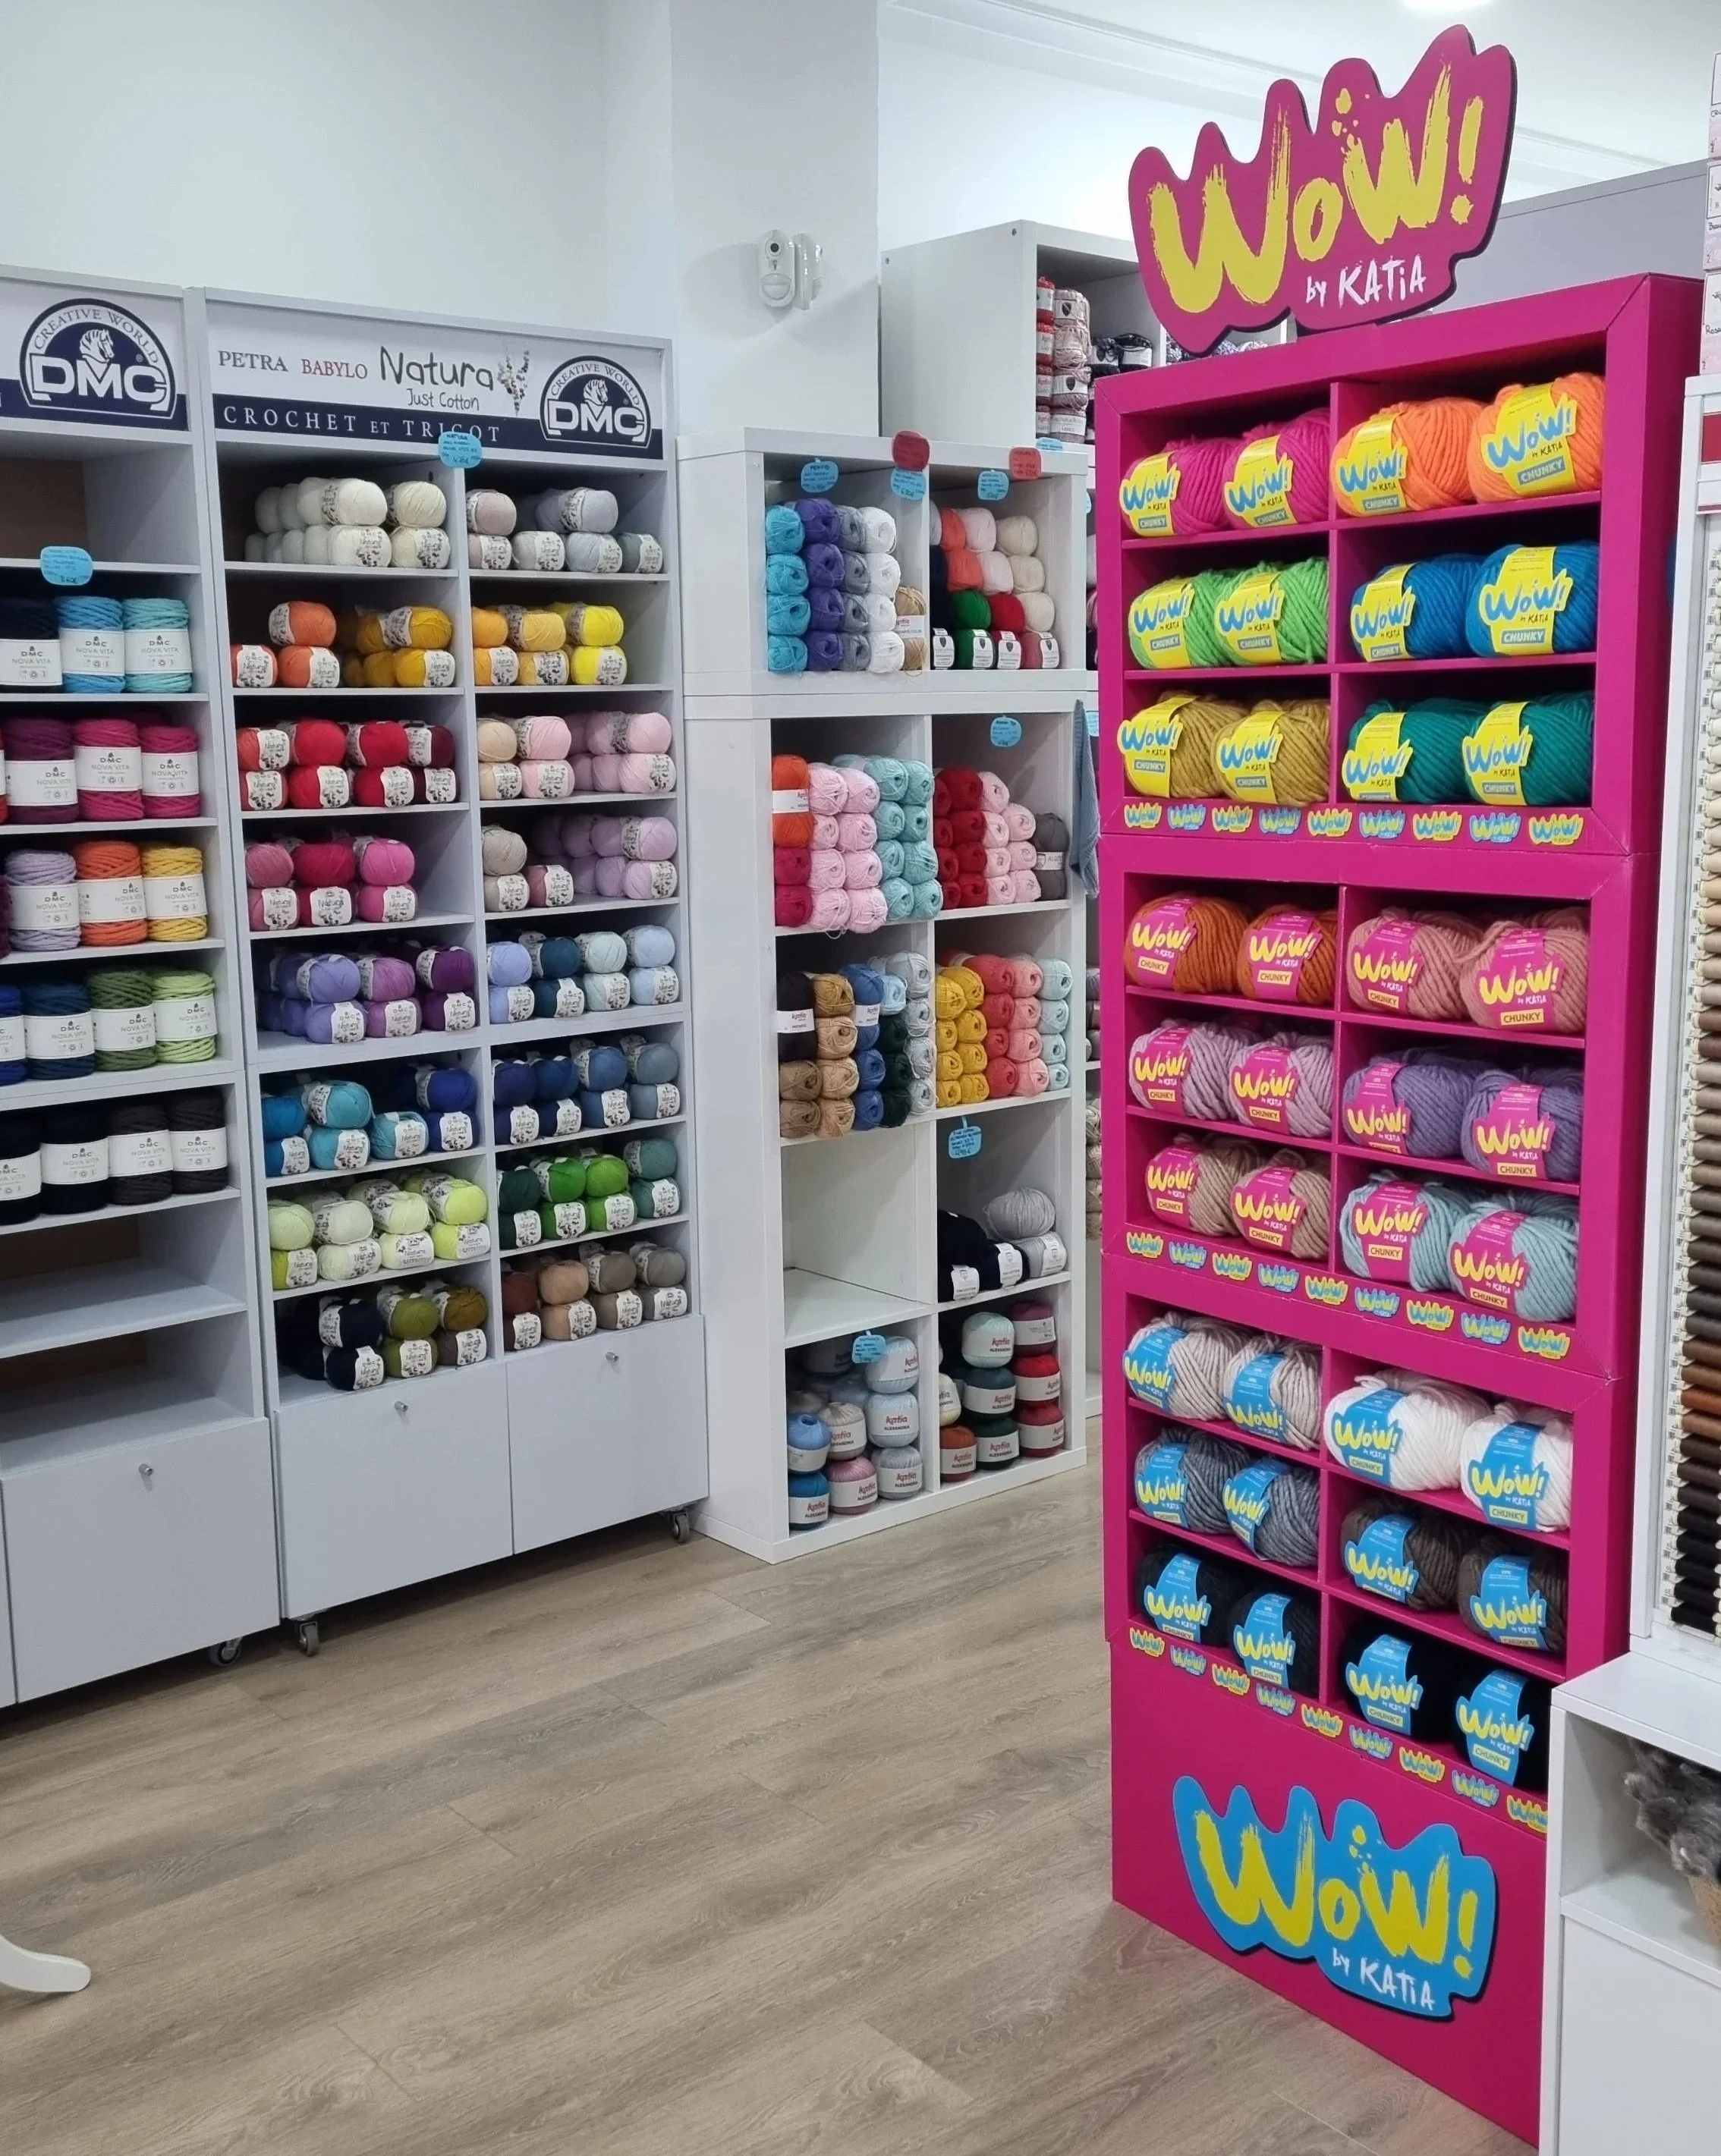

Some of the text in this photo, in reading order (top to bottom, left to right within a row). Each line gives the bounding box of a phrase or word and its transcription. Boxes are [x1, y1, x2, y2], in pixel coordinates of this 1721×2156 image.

[1147, 61, 1483, 313] WoW!
[1306, 275, 1327, 307] by
[34, 309, 159, 363] CREATIVE WORLD
[218, 350, 368, 379] PETRA BABYLO
[380, 346, 494, 391] Natura
[31, 356, 169, 411] DMC
[552, 363, 640, 406] CREATIVE WORLD
[407, 388, 480, 411] Just Cotton
[224, 406, 356, 432] CROCHET
[371, 421, 389, 433] ET
[548, 401, 647, 442] DMC
[1487, 407, 1571, 467] WoW!
[1340, 452, 1403, 492] WoW!
[1520, 458, 1565, 482] CHUNKY
[1123, 476, 1175, 511] WoW!
[1229, 468, 1288, 512] WoW!
[1364, 498, 1398, 509] CHUNKY
[1141, 517, 1166, 528] CHUNKY
[1257, 510, 1286, 524] CHUNKY
[1134, 595, 1189, 633] WoW!
[1219, 594, 1279, 632] WoW!
[1484, 580, 1565, 621] WoW!
[1355, 597, 1410, 638] WoW!
[1151, 635, 1179, 649] CHUNKY
[1239, 637, 1271, 649] CHUNKY
[1504, 630, 1543, 643] CHUNKY
[1372, 645, 1401, 658] CHUNKY
[1121, 721, 1175, 750] WoW!
[1220, 735, 1276, 768] WoW!
[1467, 736, 1527, 772] WoW!
[1136, 762, 1165, 772] CHUNKY
[1346, 749, 1404, 784] WoW!
[1237, 778, 1266, 787] CHUNKY
[1484, 784, 1515, 794] CHUNKY
[1132, 922, 1191, 951] WoW!
[1250, 932, 1315, 963] WoW!
[1141, 959, 1166, 972] CHUNKY
[1260, 973, 1289, 983] CHUNKY
[1354, 951, 1417, 983] WoW!
[1480, 961, 1559, 1004] WoW!
[1370, 992, 1398, 1005] CHUNKY
[1504, 1012, 1541, 1023] CHUNKY
[1135, 1051, 1187, 1082] WoW!
[1150, 1090, 1174, 1099] CHUNKY
[1235, 1070, 1295, 1098] WoW!
[1251, 1108, 1278, 1119] CHUNKY
[1348, 1105, 1406, 1136] WoW!
[1477, 1118, 1548, 1155] WoW!
[1147, 1164, 1194, 1191] WoW!
[1500, 1165, 1534, 1174] CHUNKY
[1159, 1201, 1181, 1212] CHUNKY
[1235, 1193, 1298, 1223] WoW!
[1355, 1204, 1423, 1235] WoW!
[1251, 1230, 1281, 1243] CHUNKY
[1370, 1246, 1400, 1258] CHUNKY
[1454, 1249, 1524, 1286] WoW!
[1473, 1291, 1505, 1306] CHUNKY
[1125, 1357, 1171, 1391] WoW!
[1226, 1403, 1282, 1430] WoW!
[1335, 1419, 1398, 1451] WoW!
[1351, 1458, 1381, 1473] CHUNKY
[1137, 1476, 1184, 1504] WoW!
[1471, 1465, 1545, 1498] WoW!
[1225, 1484, 1264, 1521] WoW!
[1492, 1507, 1526, 1521] CHUNKY
[1348, 1548, 1412, 1589] WoW!
[1147, 1592, 1207, 1623] WoW!
[1474, 1596, 1542, 1629] WoW!
[1164, 1627, 1191, 1639] CHUNKY
[1236, 1631, 1292, 1662] WoW!
[1254, 1670, 1279, 1683] CHUNKY
[1349, 1670, 1418, 1708] WoW!
[1369, 1708, 1401, 1724] CHUNKY
[1460, 1705, 1528, 1749] WoW!
[1475, 1749, 1508, 1768] CHUNKY
[1194, 1808, 1477, 1978] WoW!
[1332, 1947, 1350, 1975] by
